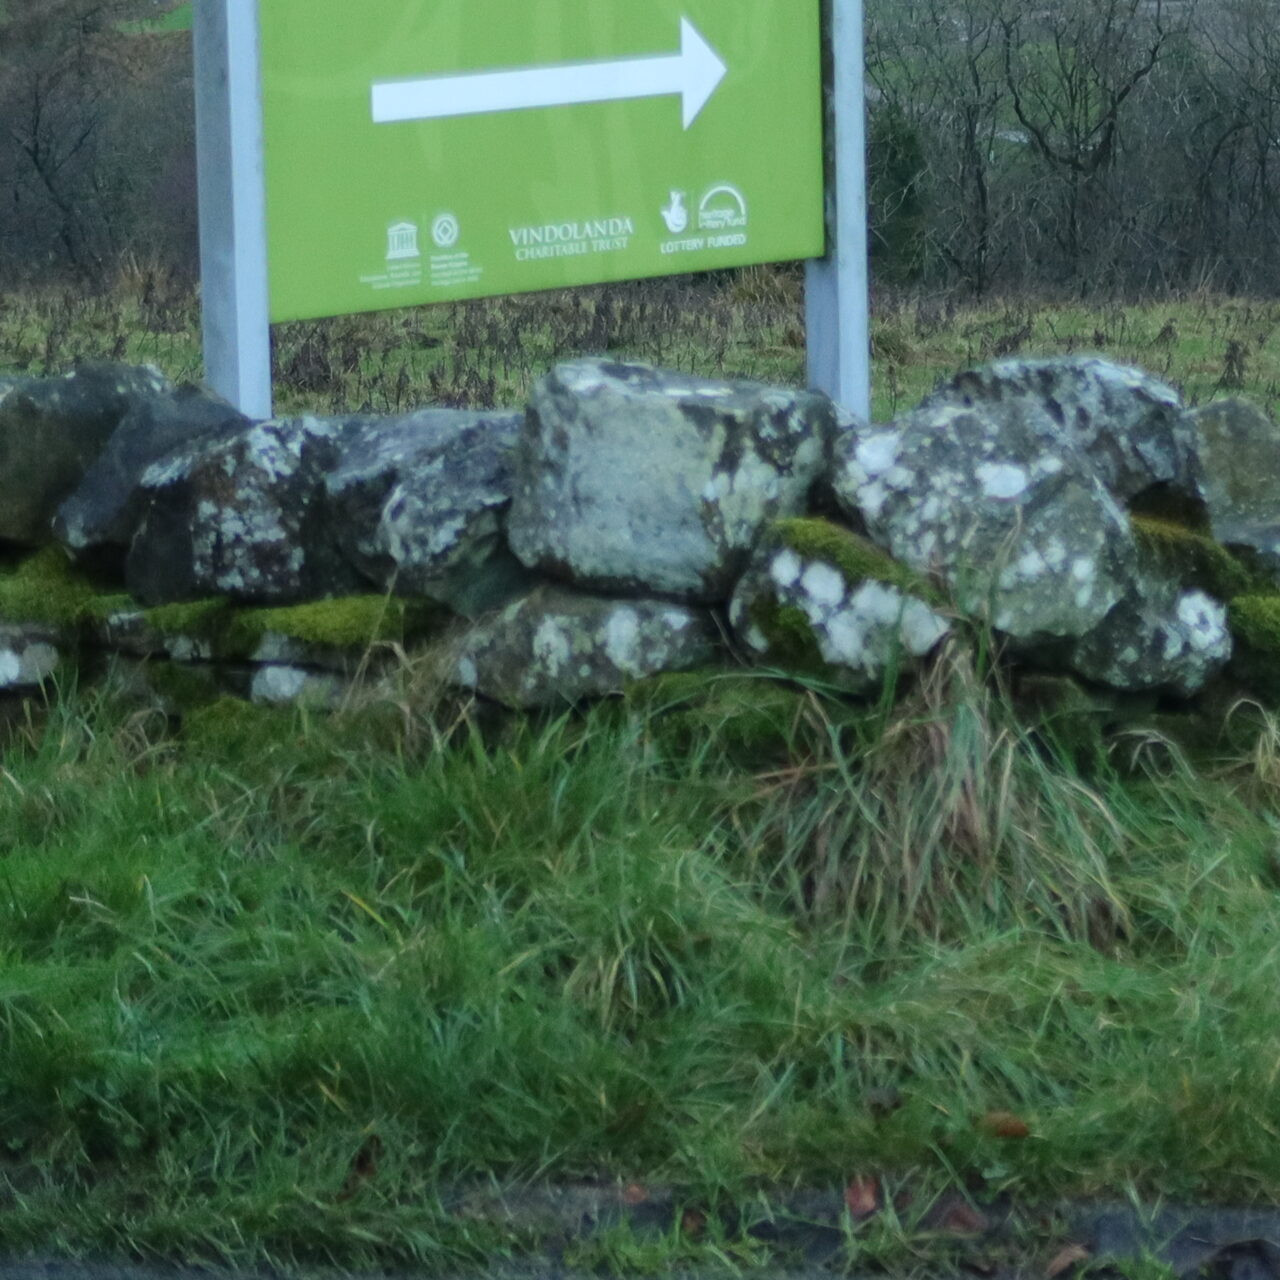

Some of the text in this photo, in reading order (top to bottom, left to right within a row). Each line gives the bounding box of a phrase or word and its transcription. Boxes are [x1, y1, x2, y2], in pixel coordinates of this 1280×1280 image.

[508, 216, 634, 246] VINDOLANDA
[660, 233, 747, 254] LOTTERY FUNDED
[515, 236, 629, 261] CHARITABLE TRUST
